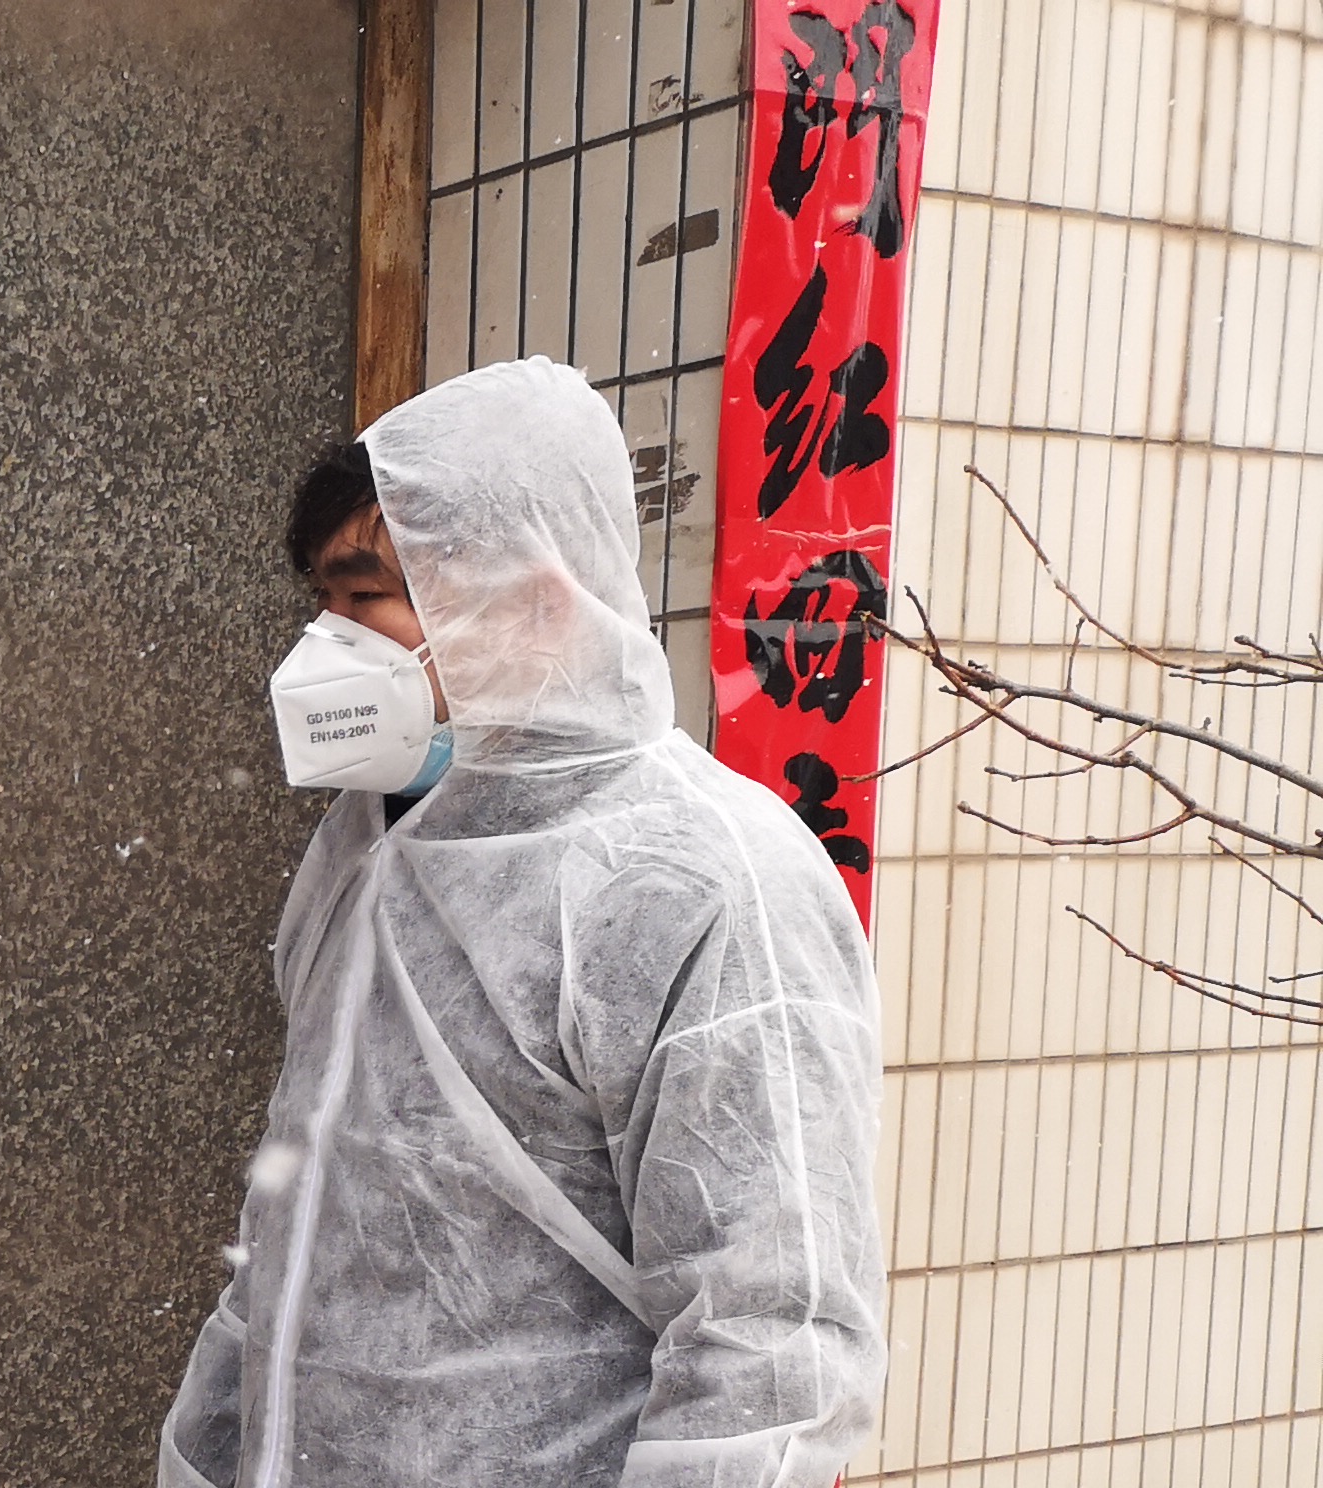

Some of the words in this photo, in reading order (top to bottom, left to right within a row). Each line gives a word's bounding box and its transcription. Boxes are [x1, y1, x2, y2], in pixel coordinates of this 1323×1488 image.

[306, 713, 323, 725] GD
[324, 708, 352, 722] 9100
[354, 704, 379, 718] N95
[310, 723, 377, 743] EN149:2001
